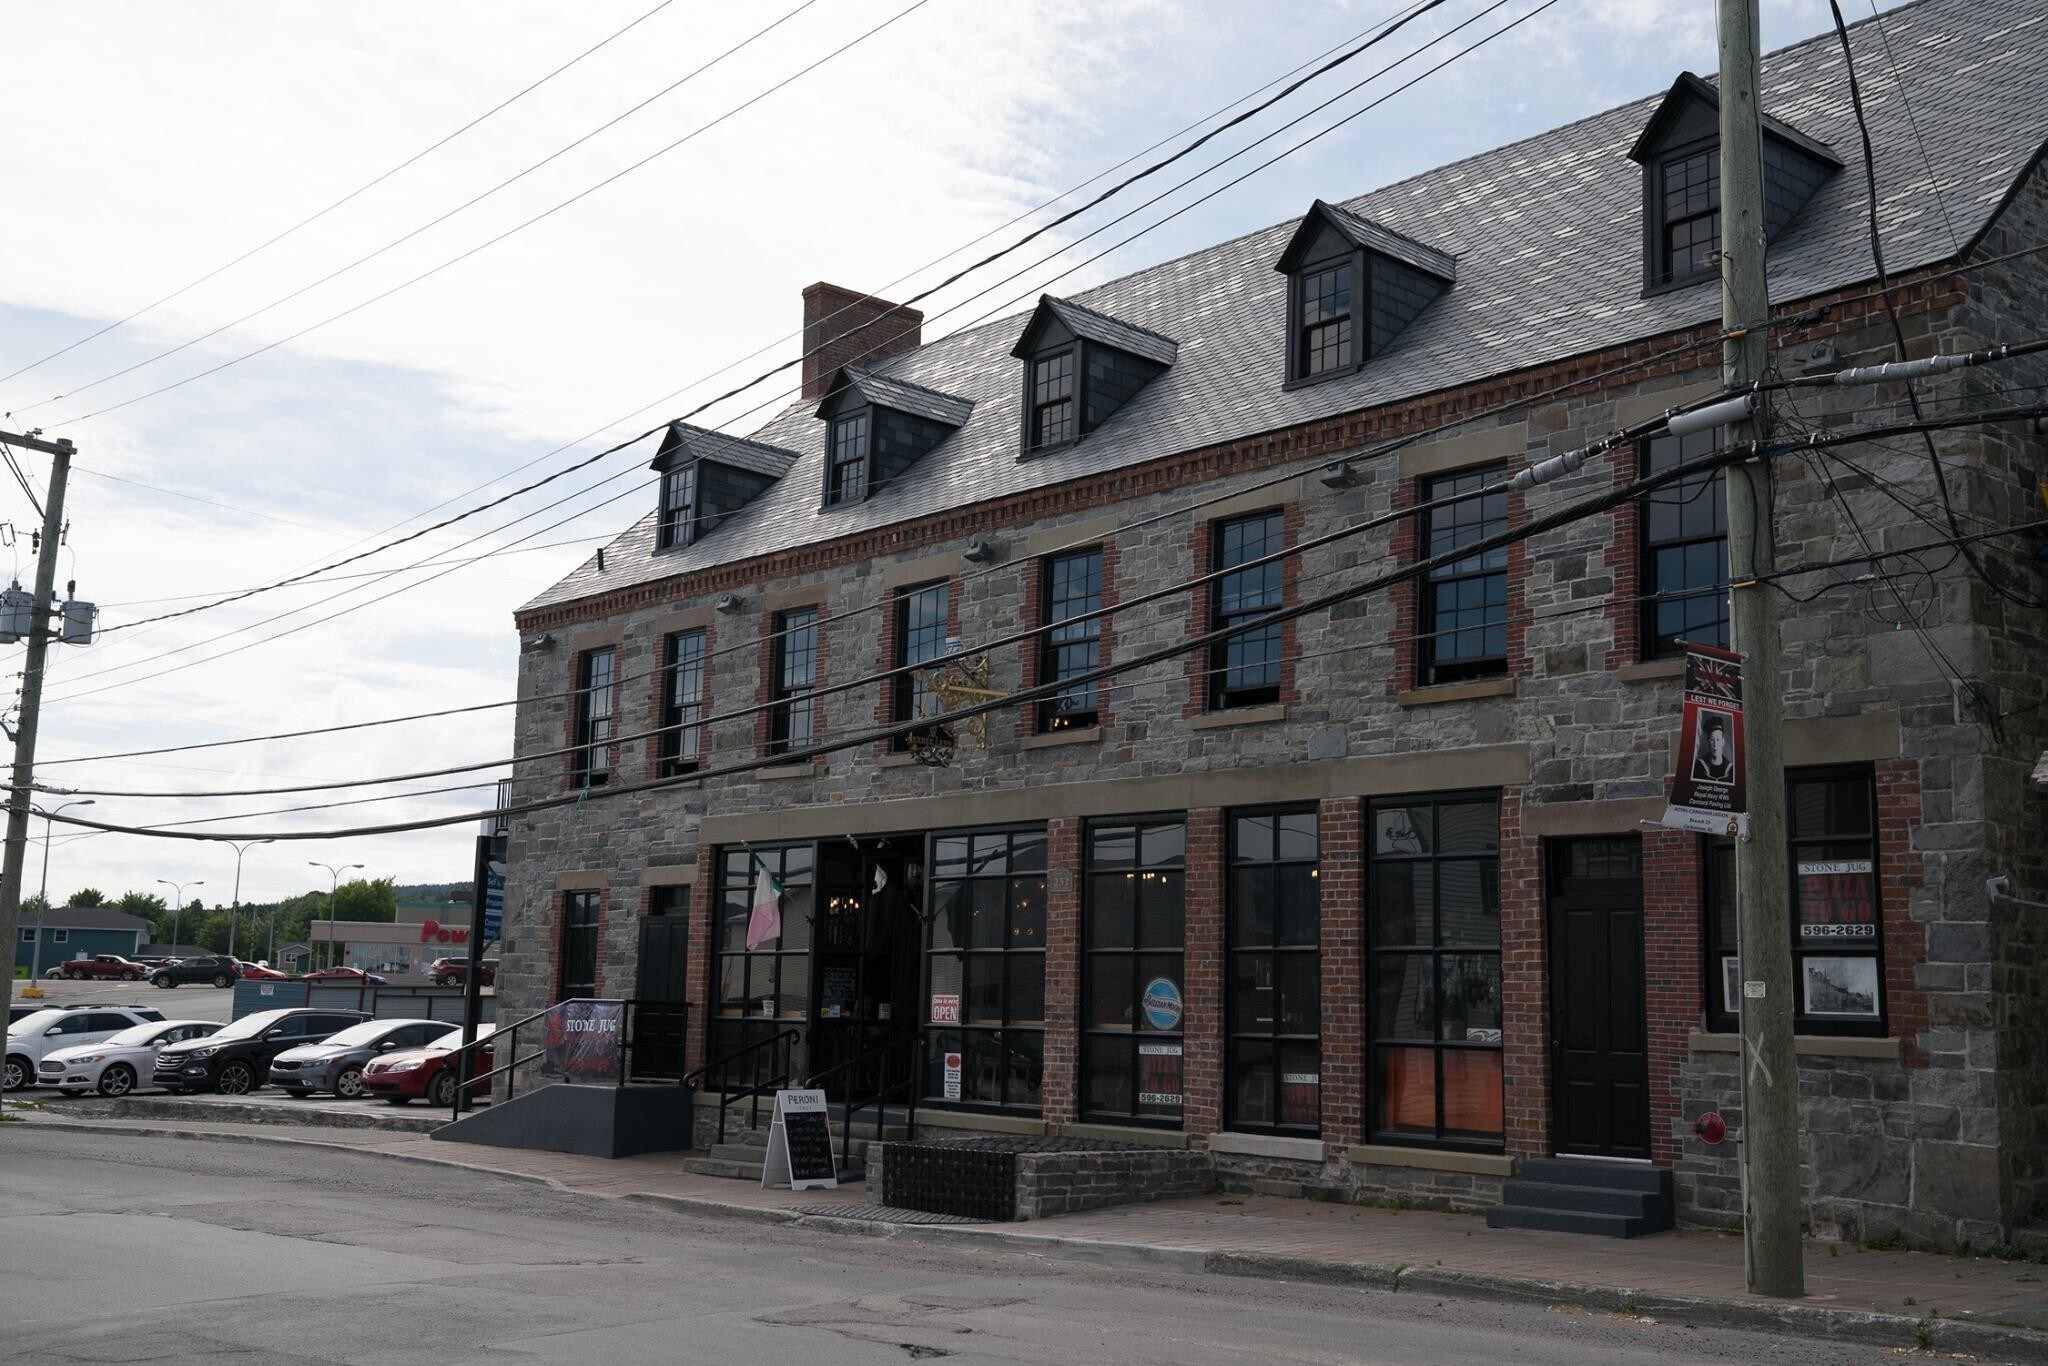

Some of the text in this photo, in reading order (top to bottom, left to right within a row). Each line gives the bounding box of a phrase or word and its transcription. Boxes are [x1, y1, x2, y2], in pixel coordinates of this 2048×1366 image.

[1690, 694, 1740, 710] LEST WE FORGET
[1707, 793, 1719, 801] Navy
[1803, 862, 1866, 873] STONE JUG
[1841, 900, 1872, 922] GO
[1803, 925, 1873, 936] 596-2629
[933, 1006, 957, 1020] OPEN
[566, 1019, 617, 1034] STONE JUG
[1143, 1046, 1162, 1054] STONE
[1284, 1074, 1309, 1082] STONE
[787, 1094, 820, 1105] PERONI
